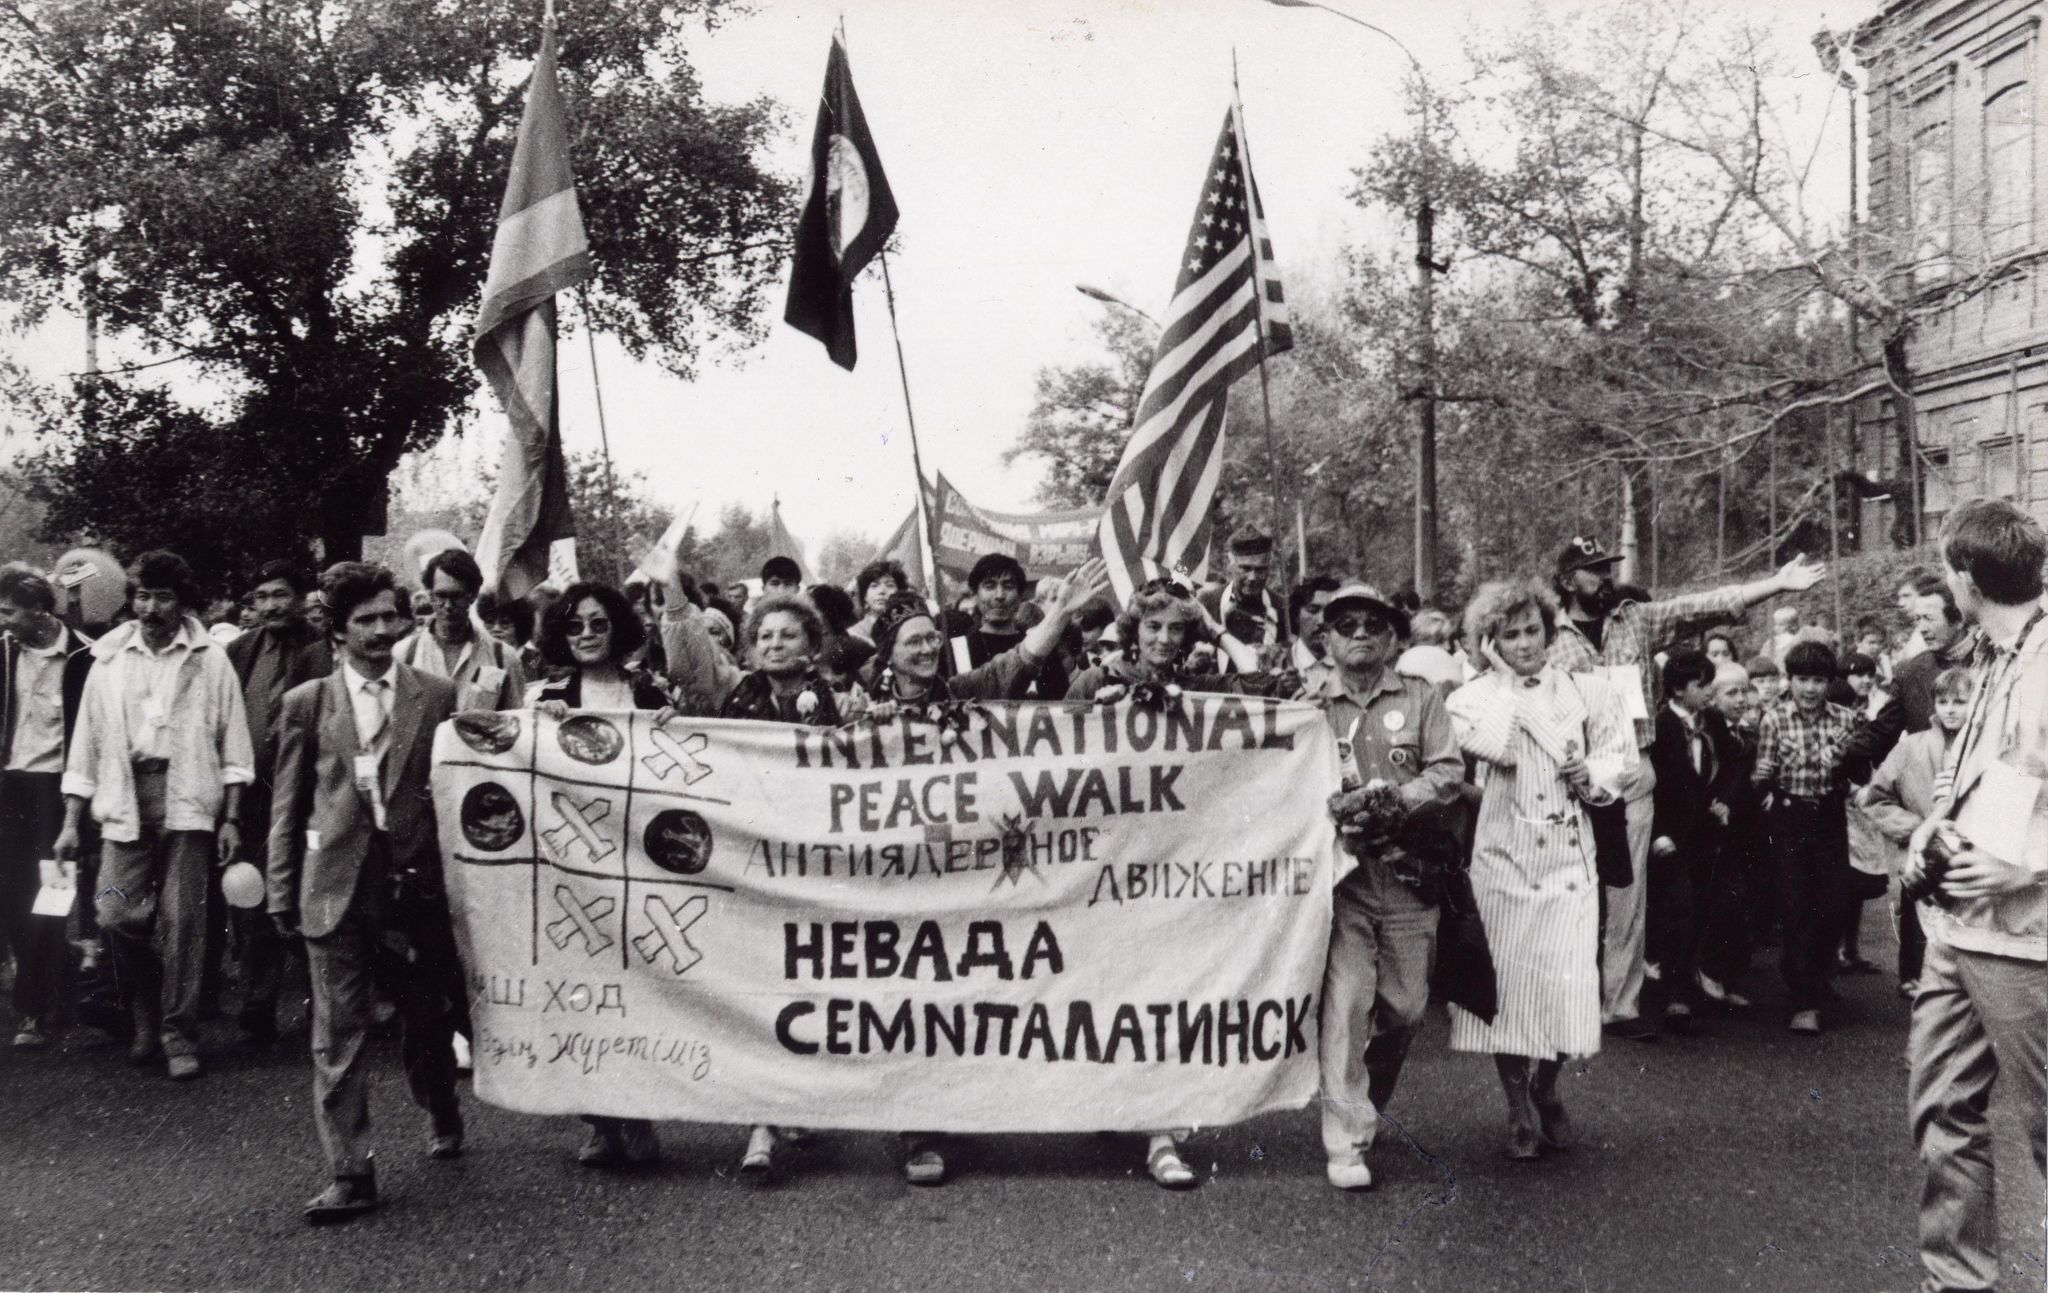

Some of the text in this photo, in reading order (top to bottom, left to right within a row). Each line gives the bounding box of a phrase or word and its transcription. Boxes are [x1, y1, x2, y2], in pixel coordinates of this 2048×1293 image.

[795, 697, 1294, 769] INTERNATIONAL
[829, 765, 1186, 833] PEACE WALK
[1088, 857, 1313, 908] ДВИЖЕНИЕ
[784, 919, 1063, 981] НЕВАДА
[543, 981, 625, 1018] ХОД
